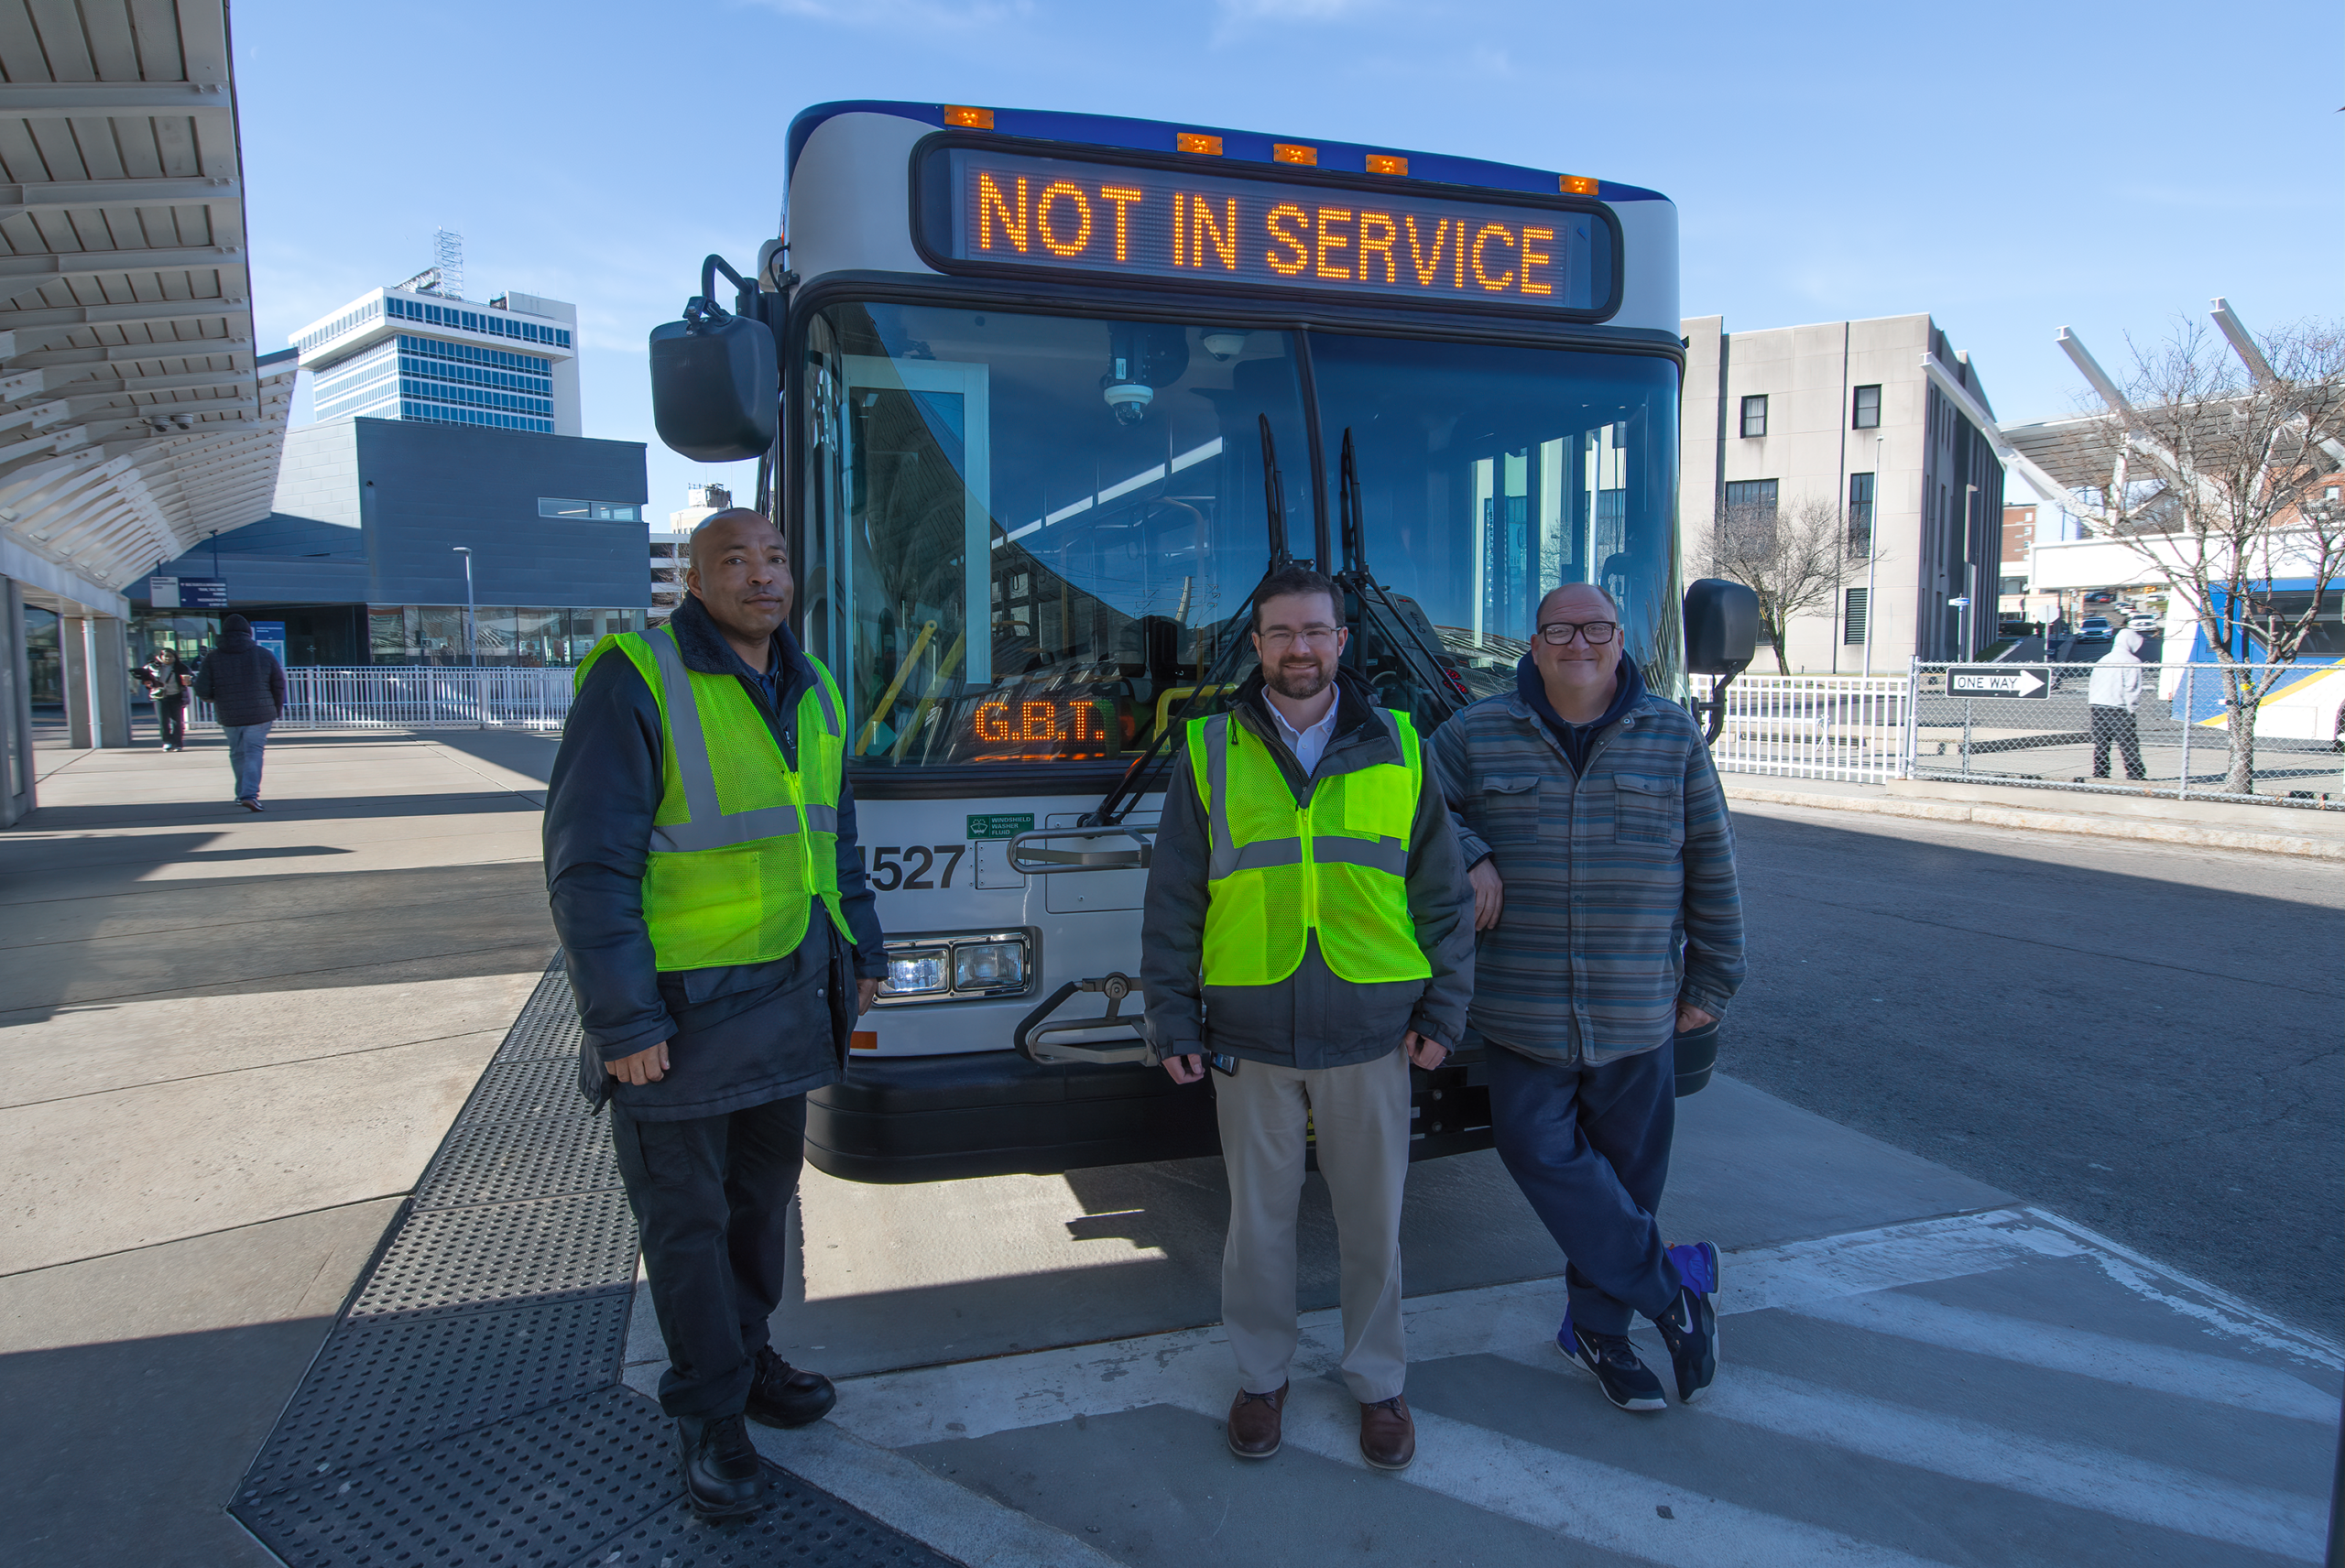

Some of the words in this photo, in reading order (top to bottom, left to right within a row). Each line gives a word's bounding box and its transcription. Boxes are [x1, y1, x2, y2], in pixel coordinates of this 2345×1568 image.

[979, 172, 1141, 262] NOT
[1173, 191, 1237, 269] IN
[1266, 202, 1554, 296] SERVICE
[1958, 677, 1984, 689] ONE
[1990, 678, 2018, 690] WAY
[976, 702, 1105, 740] G.B.T.
